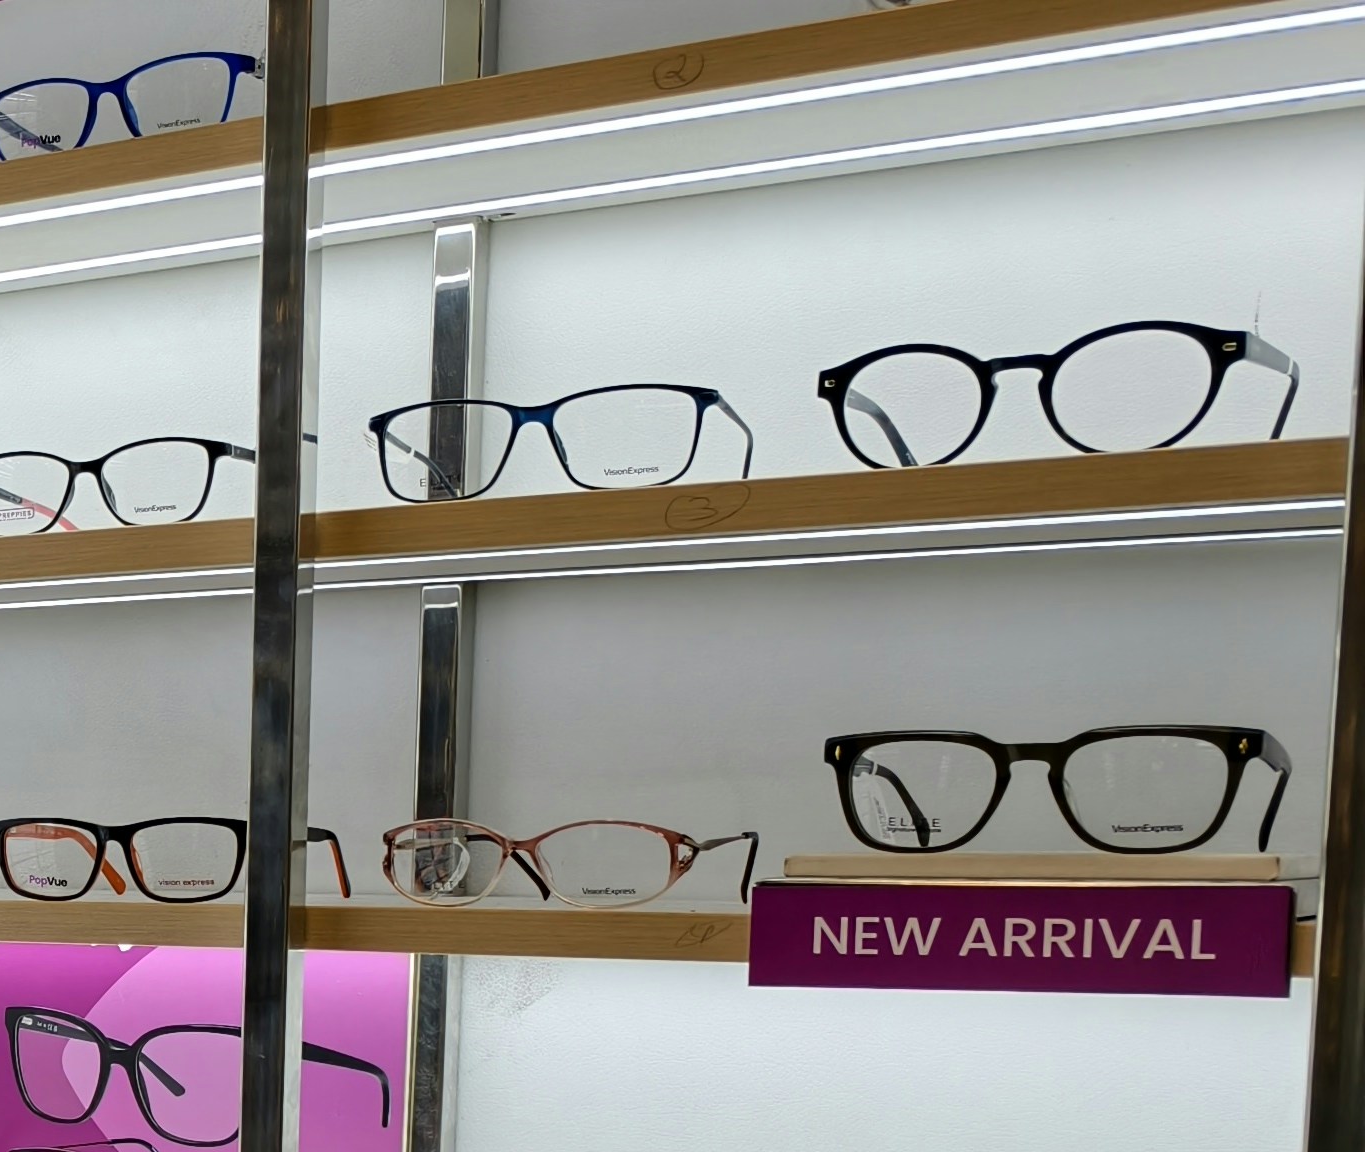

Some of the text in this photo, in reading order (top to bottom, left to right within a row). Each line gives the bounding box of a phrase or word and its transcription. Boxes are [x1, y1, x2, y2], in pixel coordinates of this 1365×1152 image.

[22, 135, 61, 148] PopVue
[604, 466, 659, 476] VisionExpress
[134, 504, 176, 514] VisionExpress
[888, 817, 940, 827] ELE
[1114, 824, 1183, 834] VisionExpress
[29, 875, 67, 888] PopVue
[183, 879, 214, 887] express
[582, 887, 635, 895] VisionExpress
[812, 916, 1217, 960] NEW ARRIVAL
